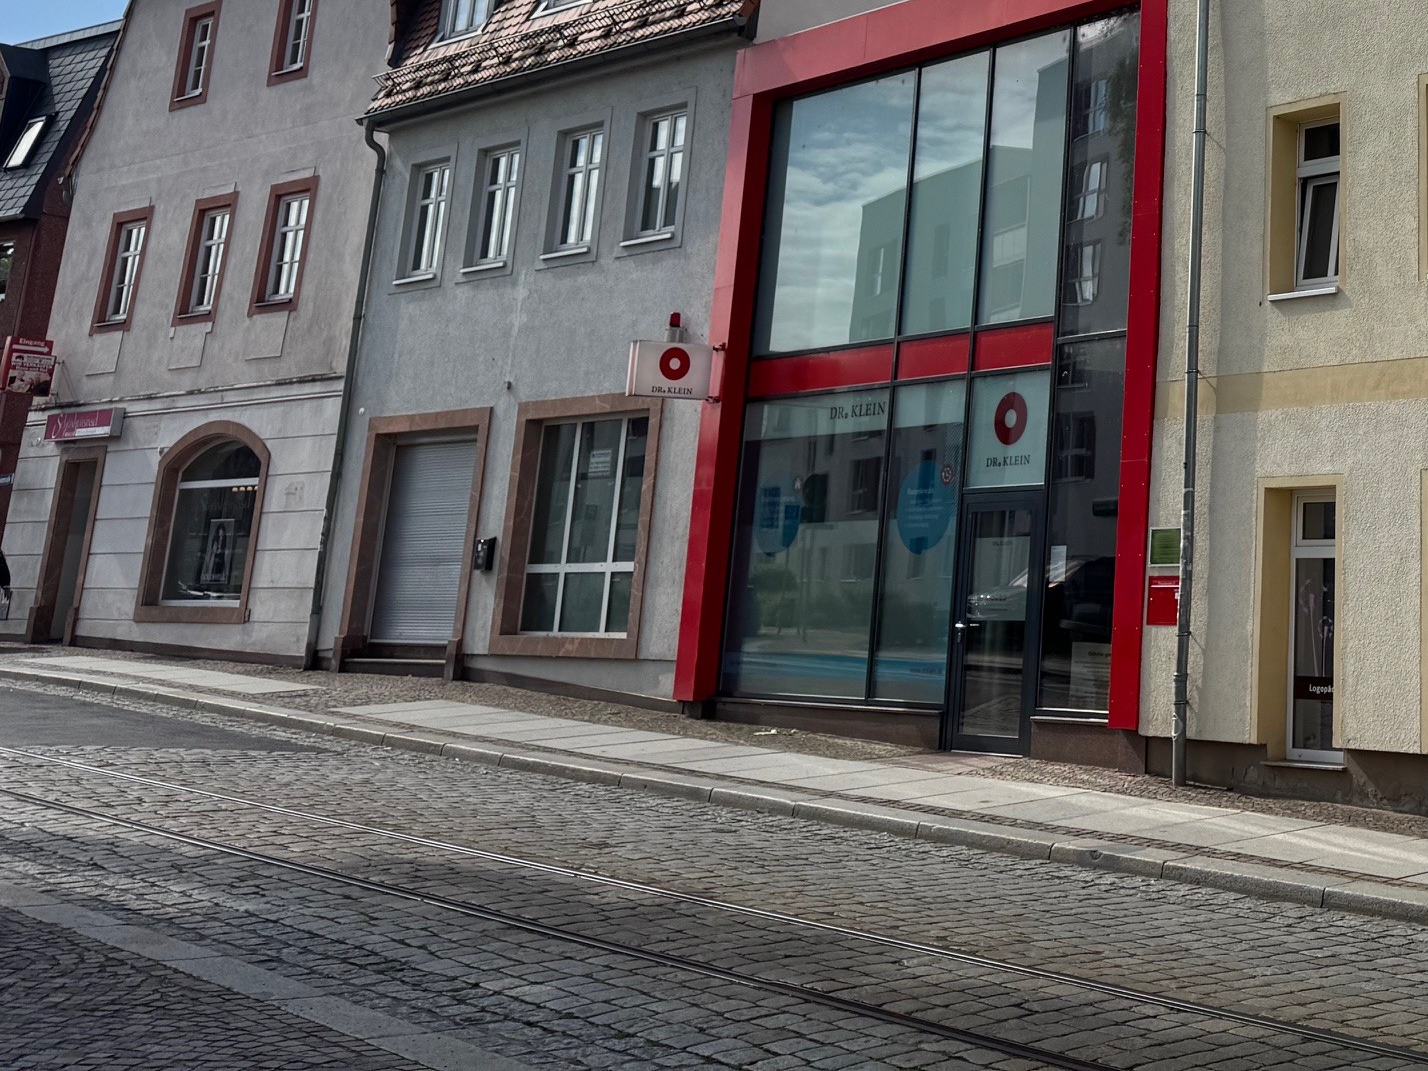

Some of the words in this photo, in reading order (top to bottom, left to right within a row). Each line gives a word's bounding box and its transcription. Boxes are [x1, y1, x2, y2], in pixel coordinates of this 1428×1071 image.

[19, 338, 45, 347] Eingang
[667, 387, 693, 395] KLEIN
[851, 401, 886, 417] KLEIN
[1002, 455, 1031, 467] KLEIN
